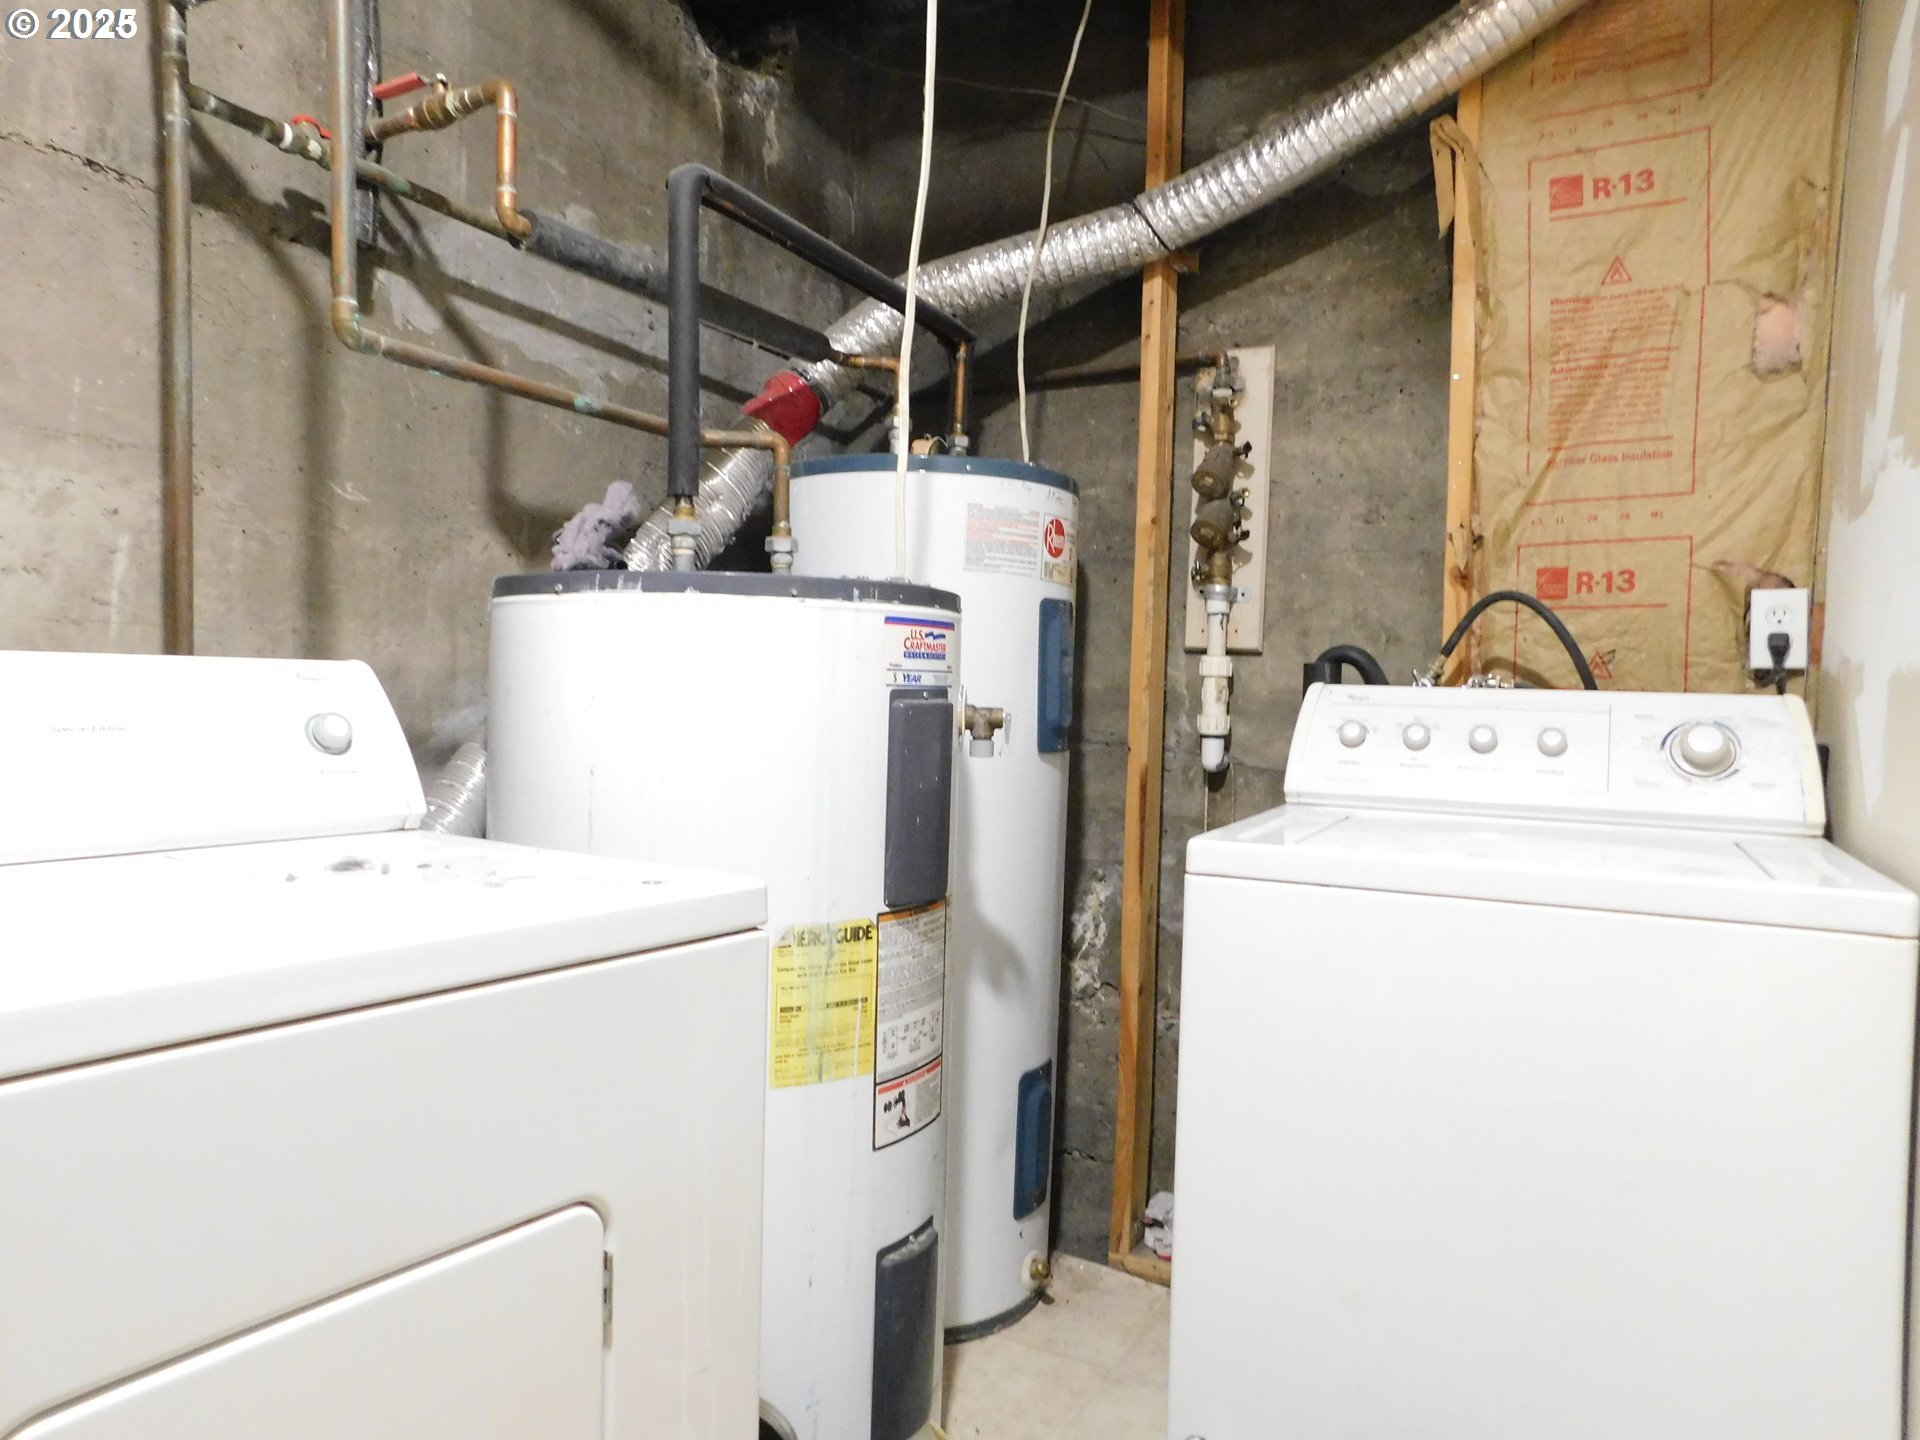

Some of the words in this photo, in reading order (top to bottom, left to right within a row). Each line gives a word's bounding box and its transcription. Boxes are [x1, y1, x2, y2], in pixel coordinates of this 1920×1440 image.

[1592, 168, 1655, 200] R-13
[1590, 452, 1618, 464] Glass
[1621, 449, 1674, 462] Insulation
[1575, 568, 1637, 595] R-13
[910, 629, 925, 641] U.S.
[902, 673, 922, 684] YEAR
